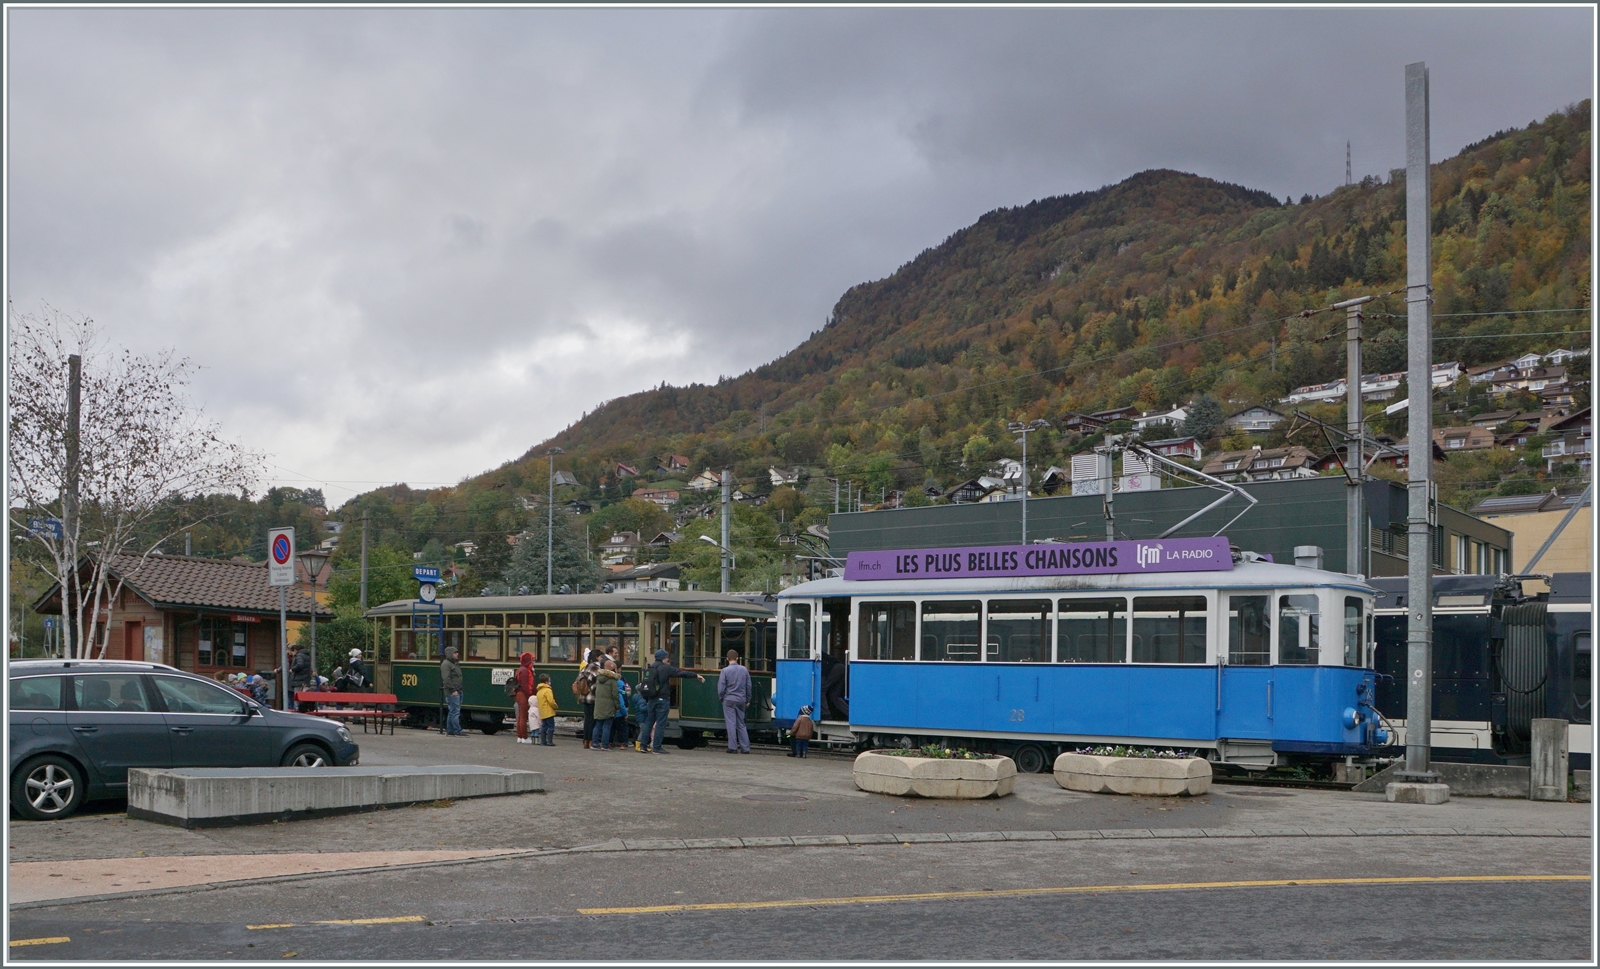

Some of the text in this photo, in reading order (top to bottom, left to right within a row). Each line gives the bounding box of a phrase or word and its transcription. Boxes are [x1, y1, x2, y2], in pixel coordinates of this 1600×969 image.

[896, 546, 1118, 574] LES PLUS BELLES CHANSONS
[1136, 544, 1160, 569] lfm
[1166, 549, 1213, 560] LA RADIO
[858, 560, 882, 571] lfm.ch
[415, 568, 437, 576] DEPART
[401, 673, 418, 687] 370
